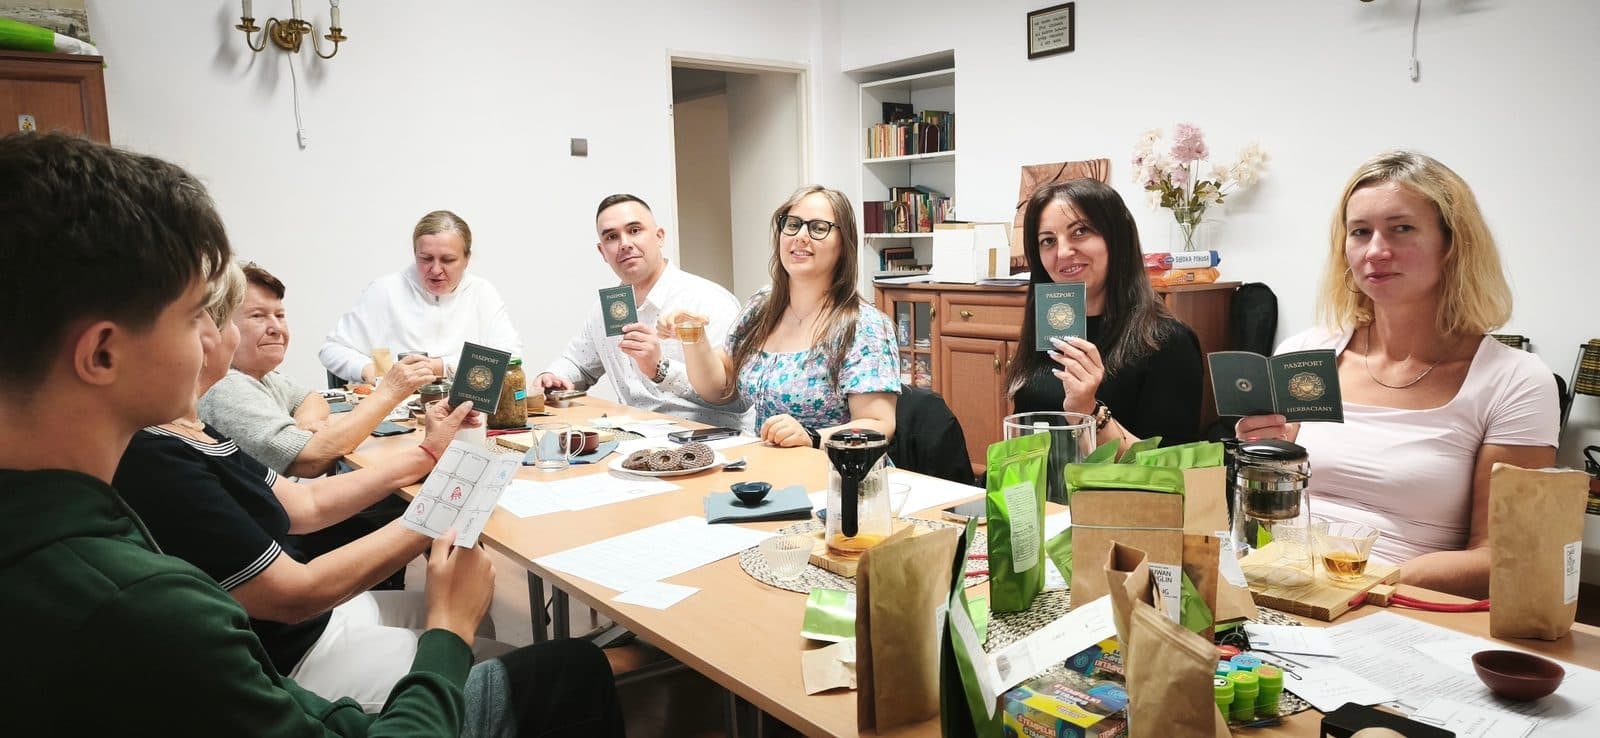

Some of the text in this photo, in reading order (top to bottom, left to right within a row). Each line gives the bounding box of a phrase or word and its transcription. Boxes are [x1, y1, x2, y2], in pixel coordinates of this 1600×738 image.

[471, 353, 499, 365] PASZPORT
[1283, 360, 1324, 369] PASZPORT
[458, 392, 490, 404] HERBACIANY
